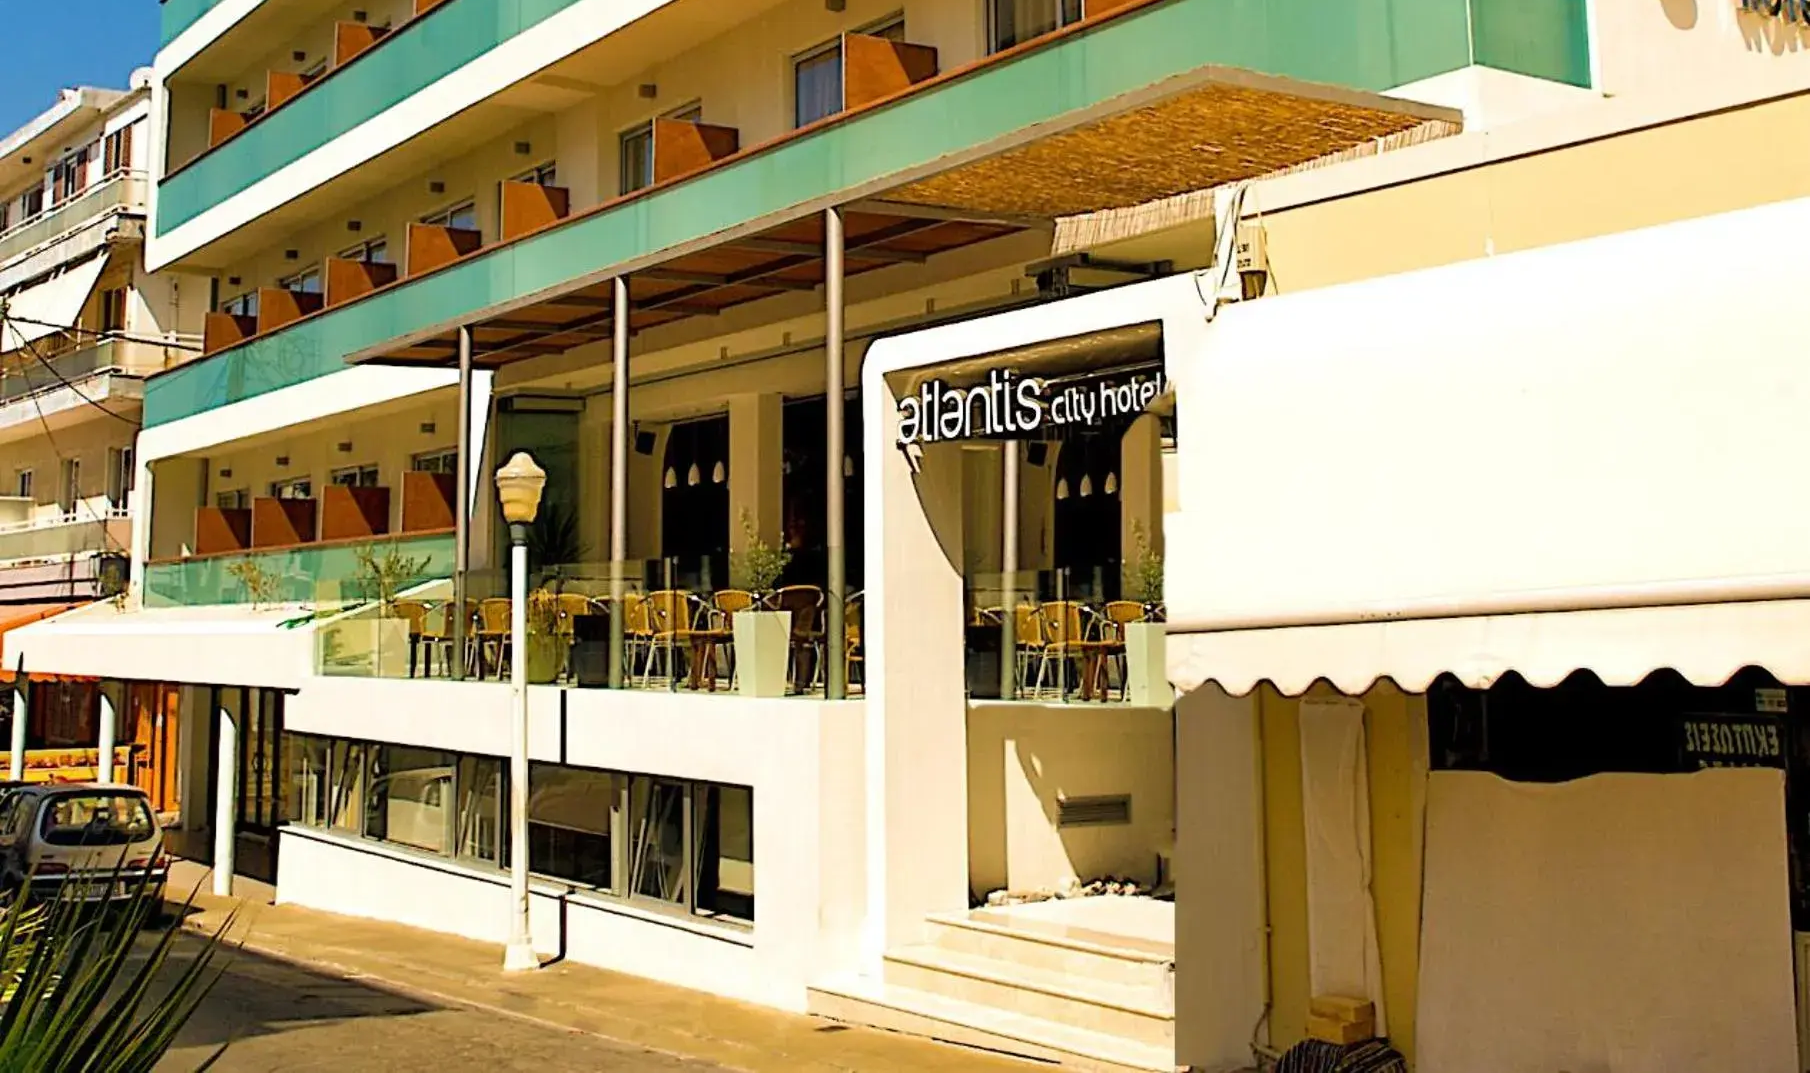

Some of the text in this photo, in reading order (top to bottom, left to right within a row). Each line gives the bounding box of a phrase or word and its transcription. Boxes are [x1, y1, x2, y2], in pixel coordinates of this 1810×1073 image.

[899, 369, 1162, 444] atlantis city hotel
